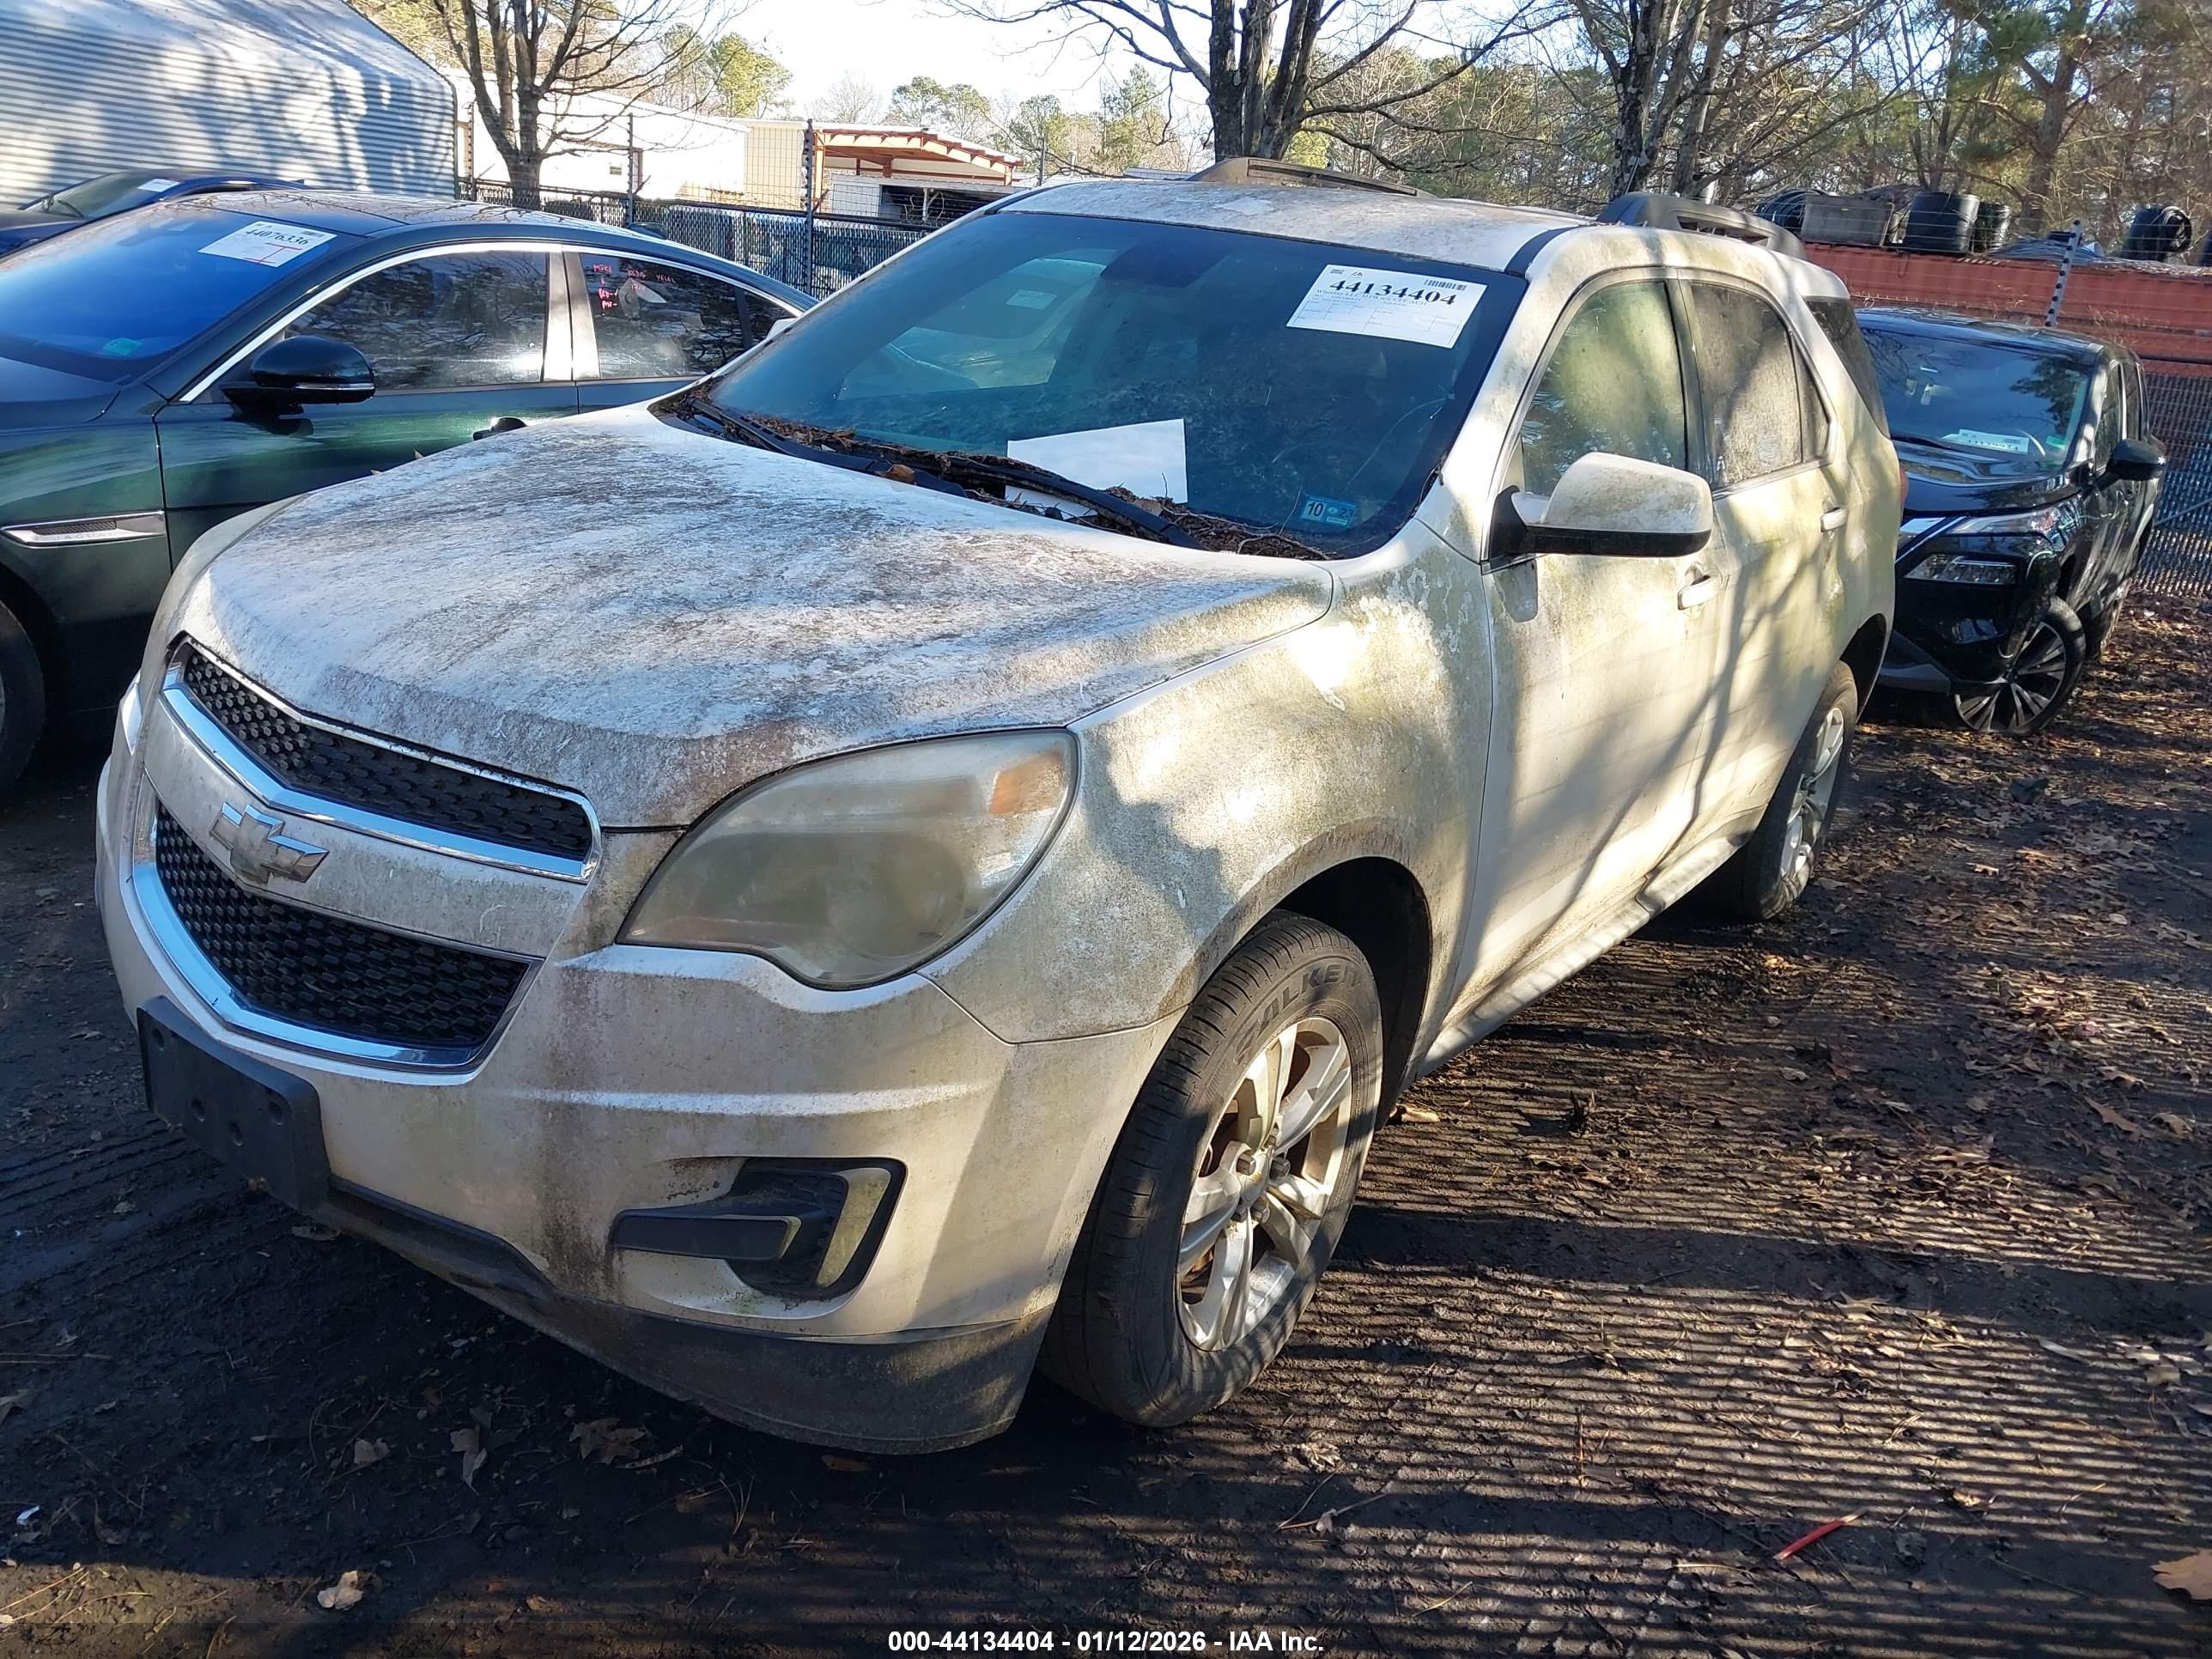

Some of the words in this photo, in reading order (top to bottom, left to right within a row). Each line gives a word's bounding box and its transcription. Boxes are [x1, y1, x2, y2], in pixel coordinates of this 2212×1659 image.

[244, 228, 310, 246] 44076336
[1329, 279, 1458, 306] 44134404
[1307, 501, 1324, 517] 10
